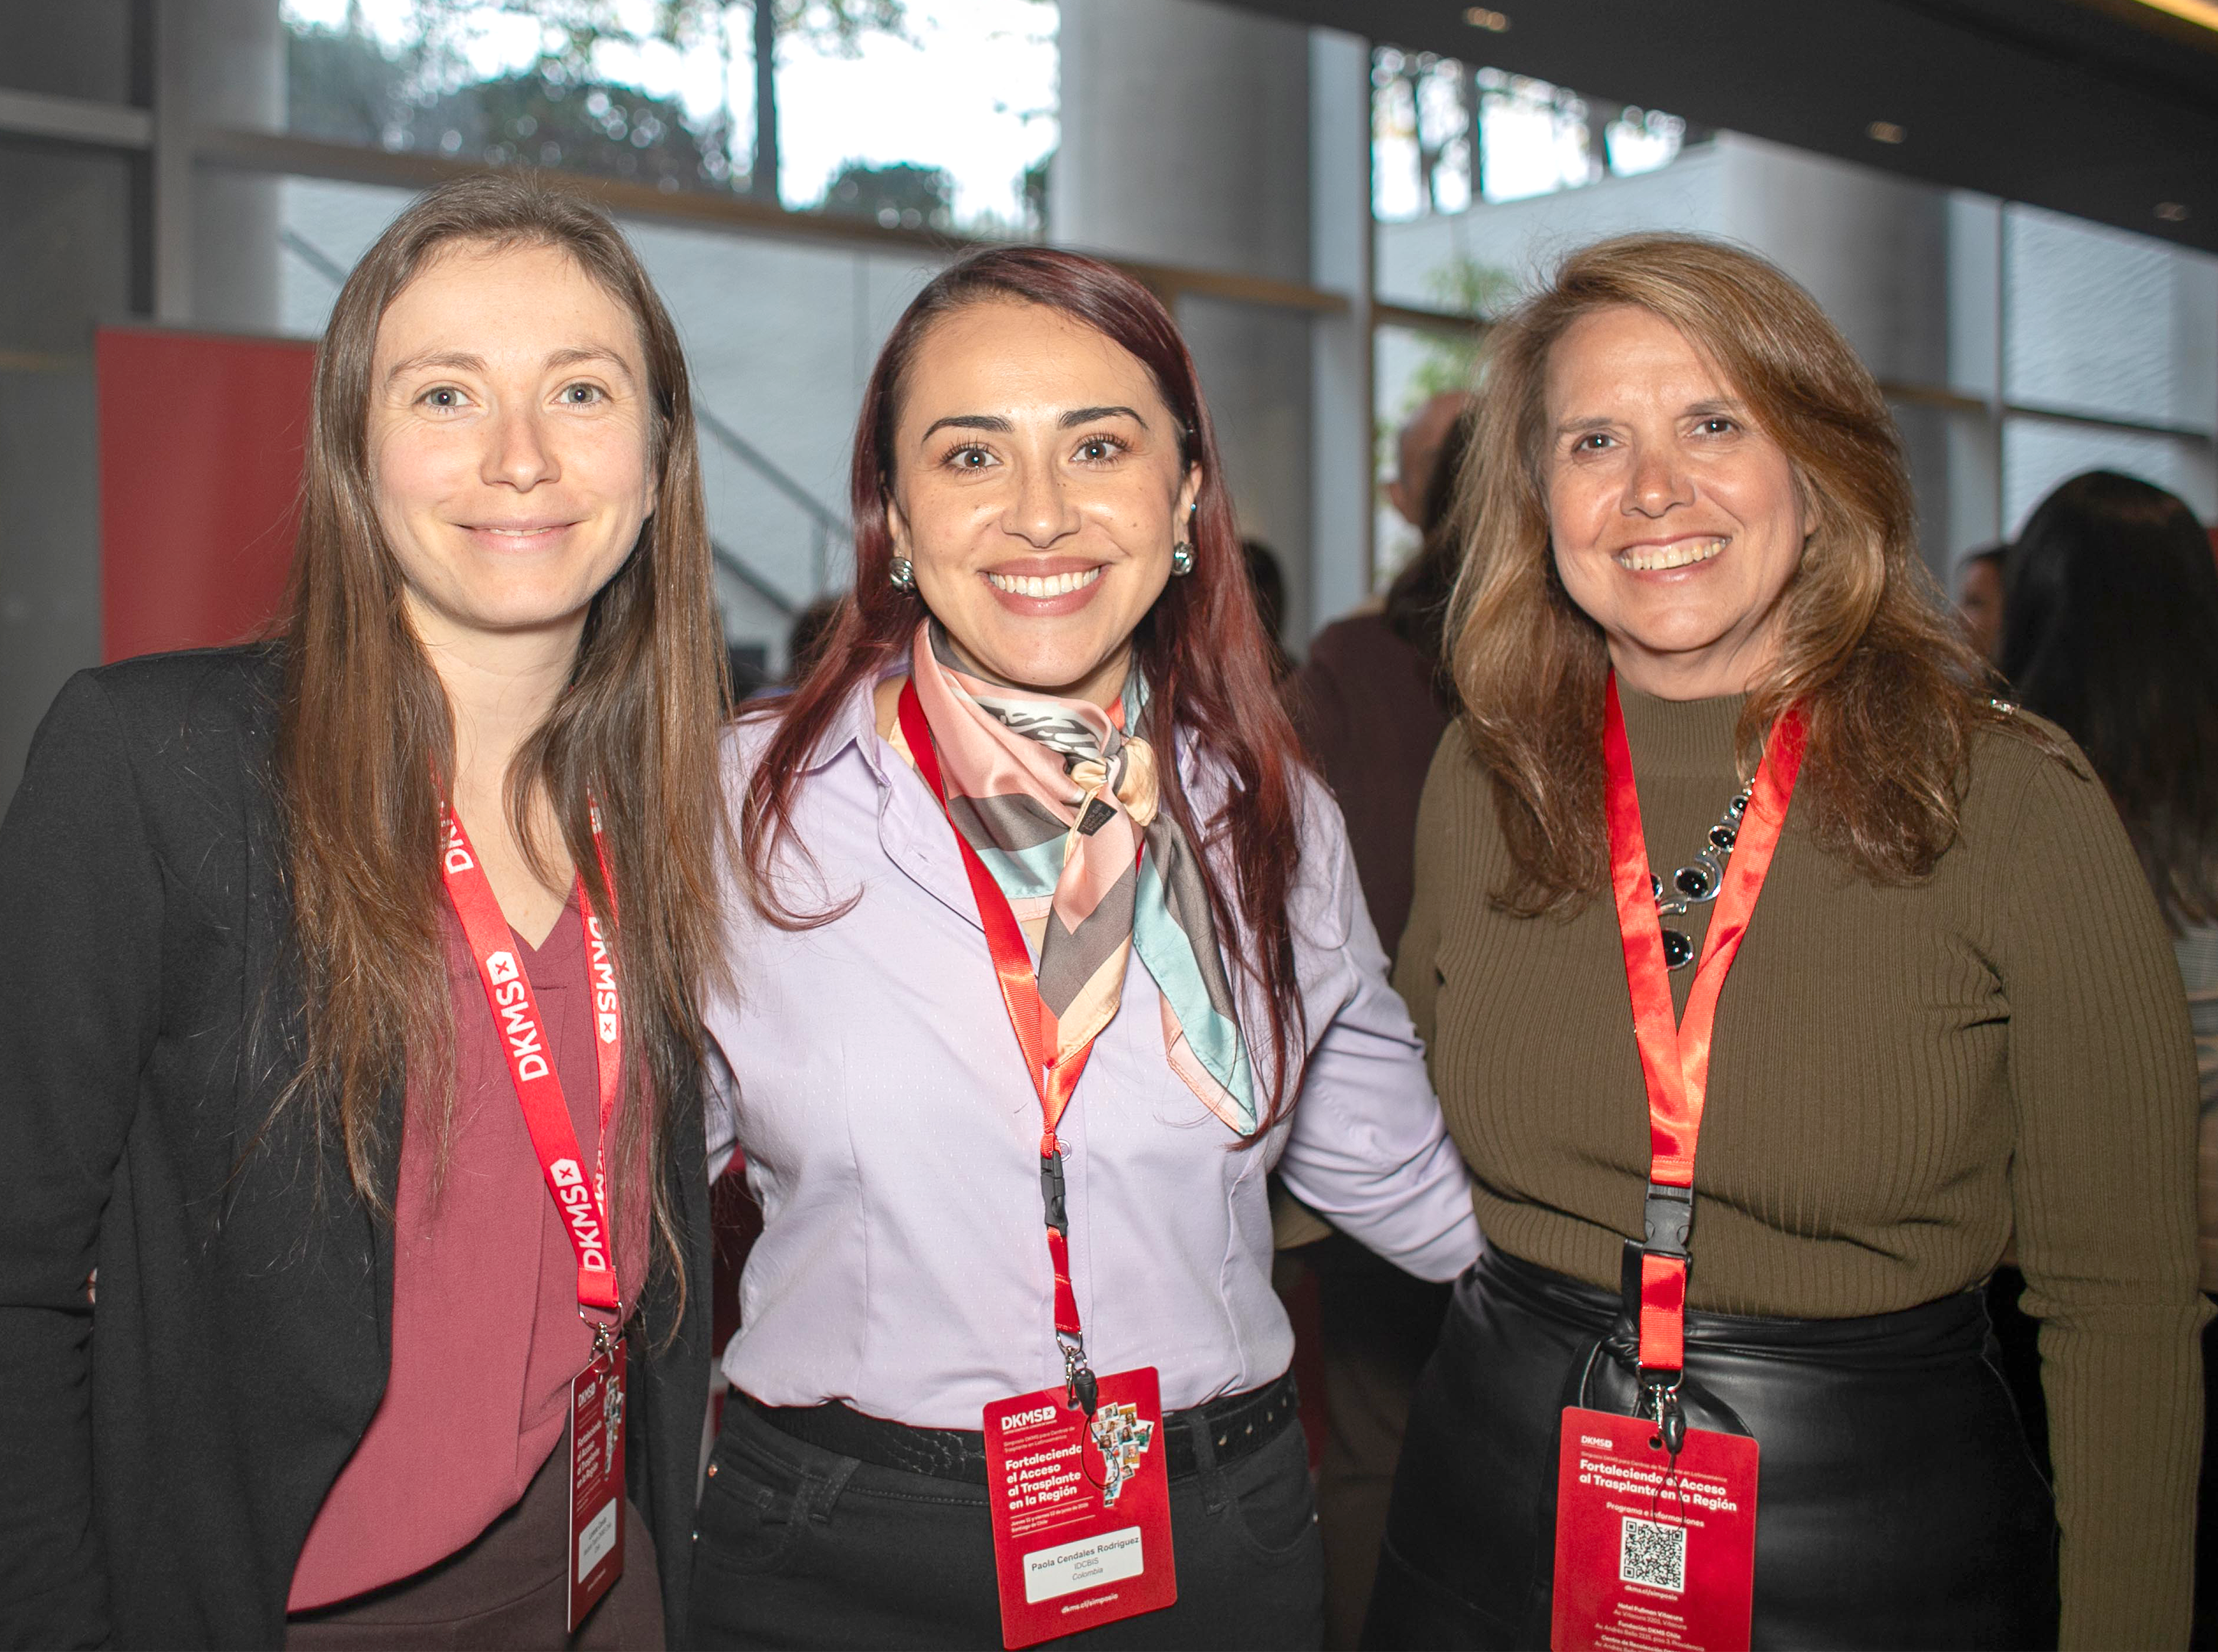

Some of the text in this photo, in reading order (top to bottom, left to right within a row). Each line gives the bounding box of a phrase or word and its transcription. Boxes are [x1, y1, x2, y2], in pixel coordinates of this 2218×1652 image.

[496, 980, 549, 1082] DKMS
[560, 1185, 607, 1273] DKMS
[1001, 1407, 1043, 1430] DKMS
[1581, 1435, 1605, 1446] DKMS
[1006, 1444, 1082, 1471] Fortaleciendo
[1007, 1464, 1061, 1483] el Acceso
[1580, 1459, 1663, 1484] Fortaleciendo
[1680, 1478, 1726, 1495] Acceso
[1008, 1472, 1081, 1497] al Trasplante
[1579, 1473, 1591, 1484] al
[1593, 1474, 1658, 1497] Trasplante
[1660, 1489, 1676, 1500] en
[1693, 1493, 1737, 1511] Región
[1010, 1485, 1078, 1510] en la Región
[1606, 1501, 1643, 1515] Programa
[1032, 1559, 1055, 1571] Paola
[1057, 1548, 1095, 1564] Cendales
[1074, 1557, 1099, 1570] IDCBIS
[1072, 1567, 1104, 1581] Colombia
[1624, 1585, 1678, 1601] dkms.cl/simposio
[1618, 1602, 1634, 1611] Hotel
[1657, 1610, 1683, 1621] Vitacura
[1601, 1634, 1621, 1644] Centro
[1647, 1626, 1665, 1636] DKMS
[1666, 1631, 1681, 1640] Chile
